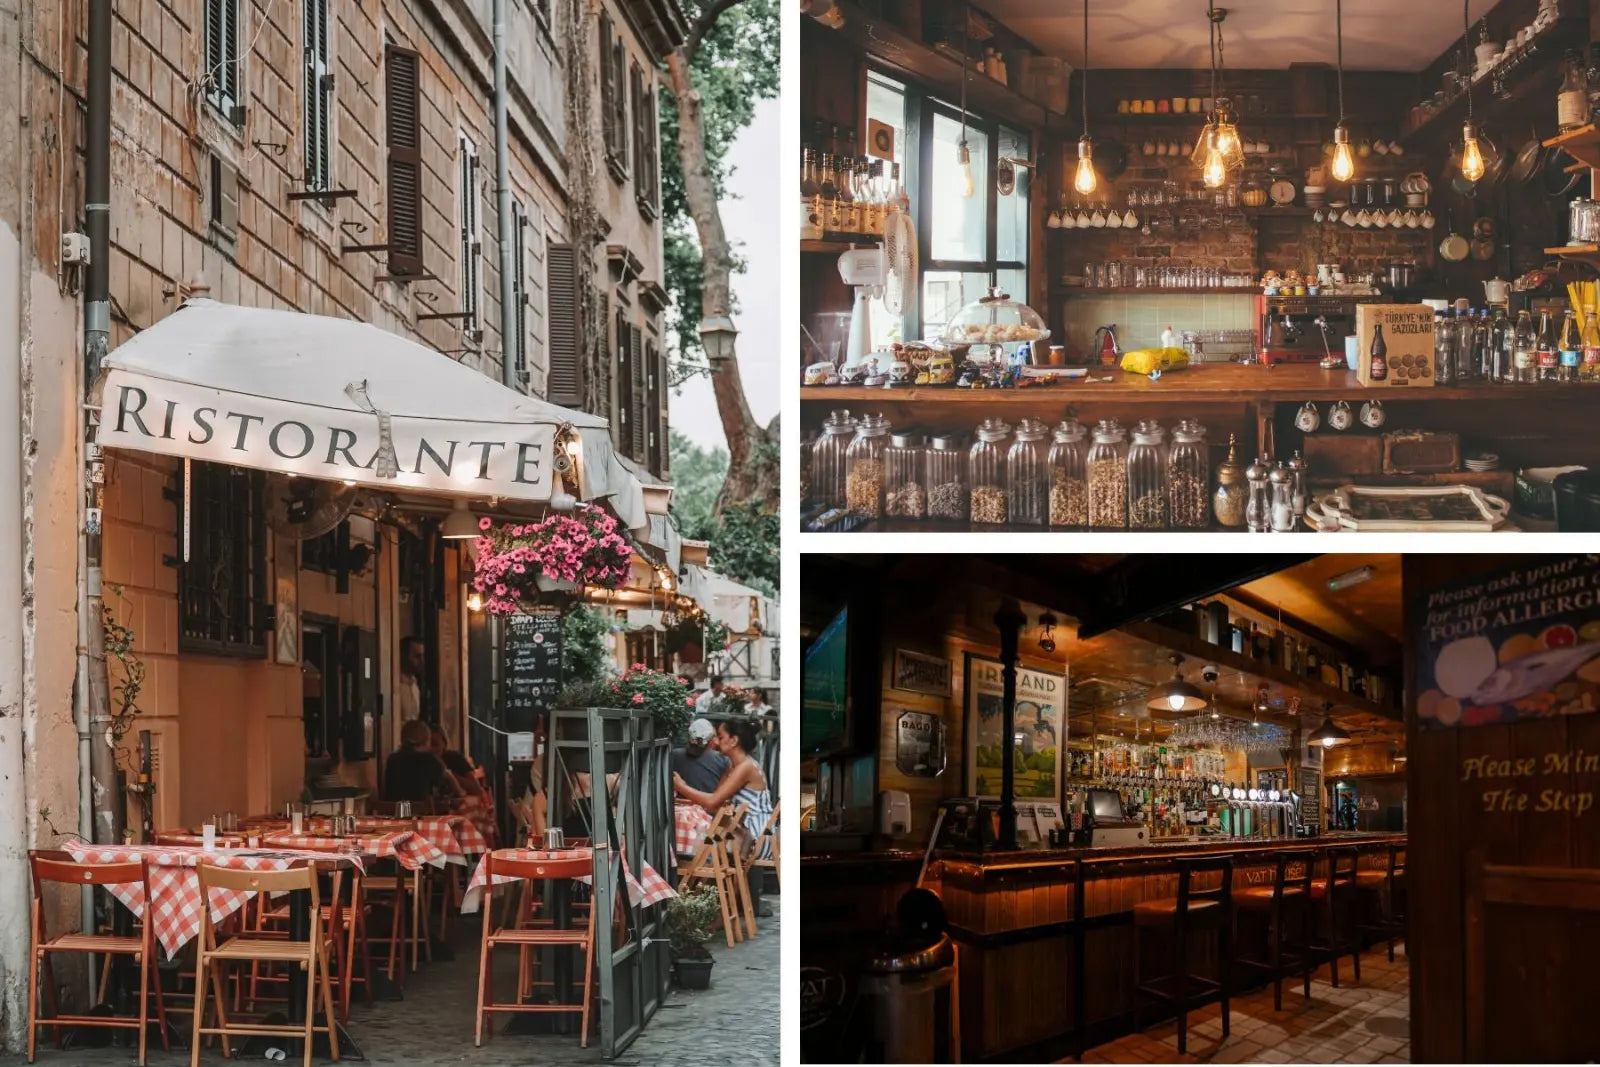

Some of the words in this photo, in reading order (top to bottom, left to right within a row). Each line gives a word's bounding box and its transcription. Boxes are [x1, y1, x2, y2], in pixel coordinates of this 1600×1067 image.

[1391, 324, 1432, 334] GAZOZLARI
[1428, 583, 1484, 609] Please
[1488, 571, 1522, 588] ask
[1526, 556, 1578, 584] your
[1424, 609, 1451, 631] for
[1457, 573, 1585, 619] information
[1429, 615, 1487, 641] FOOD
[1460, 754, 1536, 782] Please
[1482, 788, 1528, 812] The
[1535, 788, 1593, 817] Step
[1246, 870, 1267, 884] VAT
